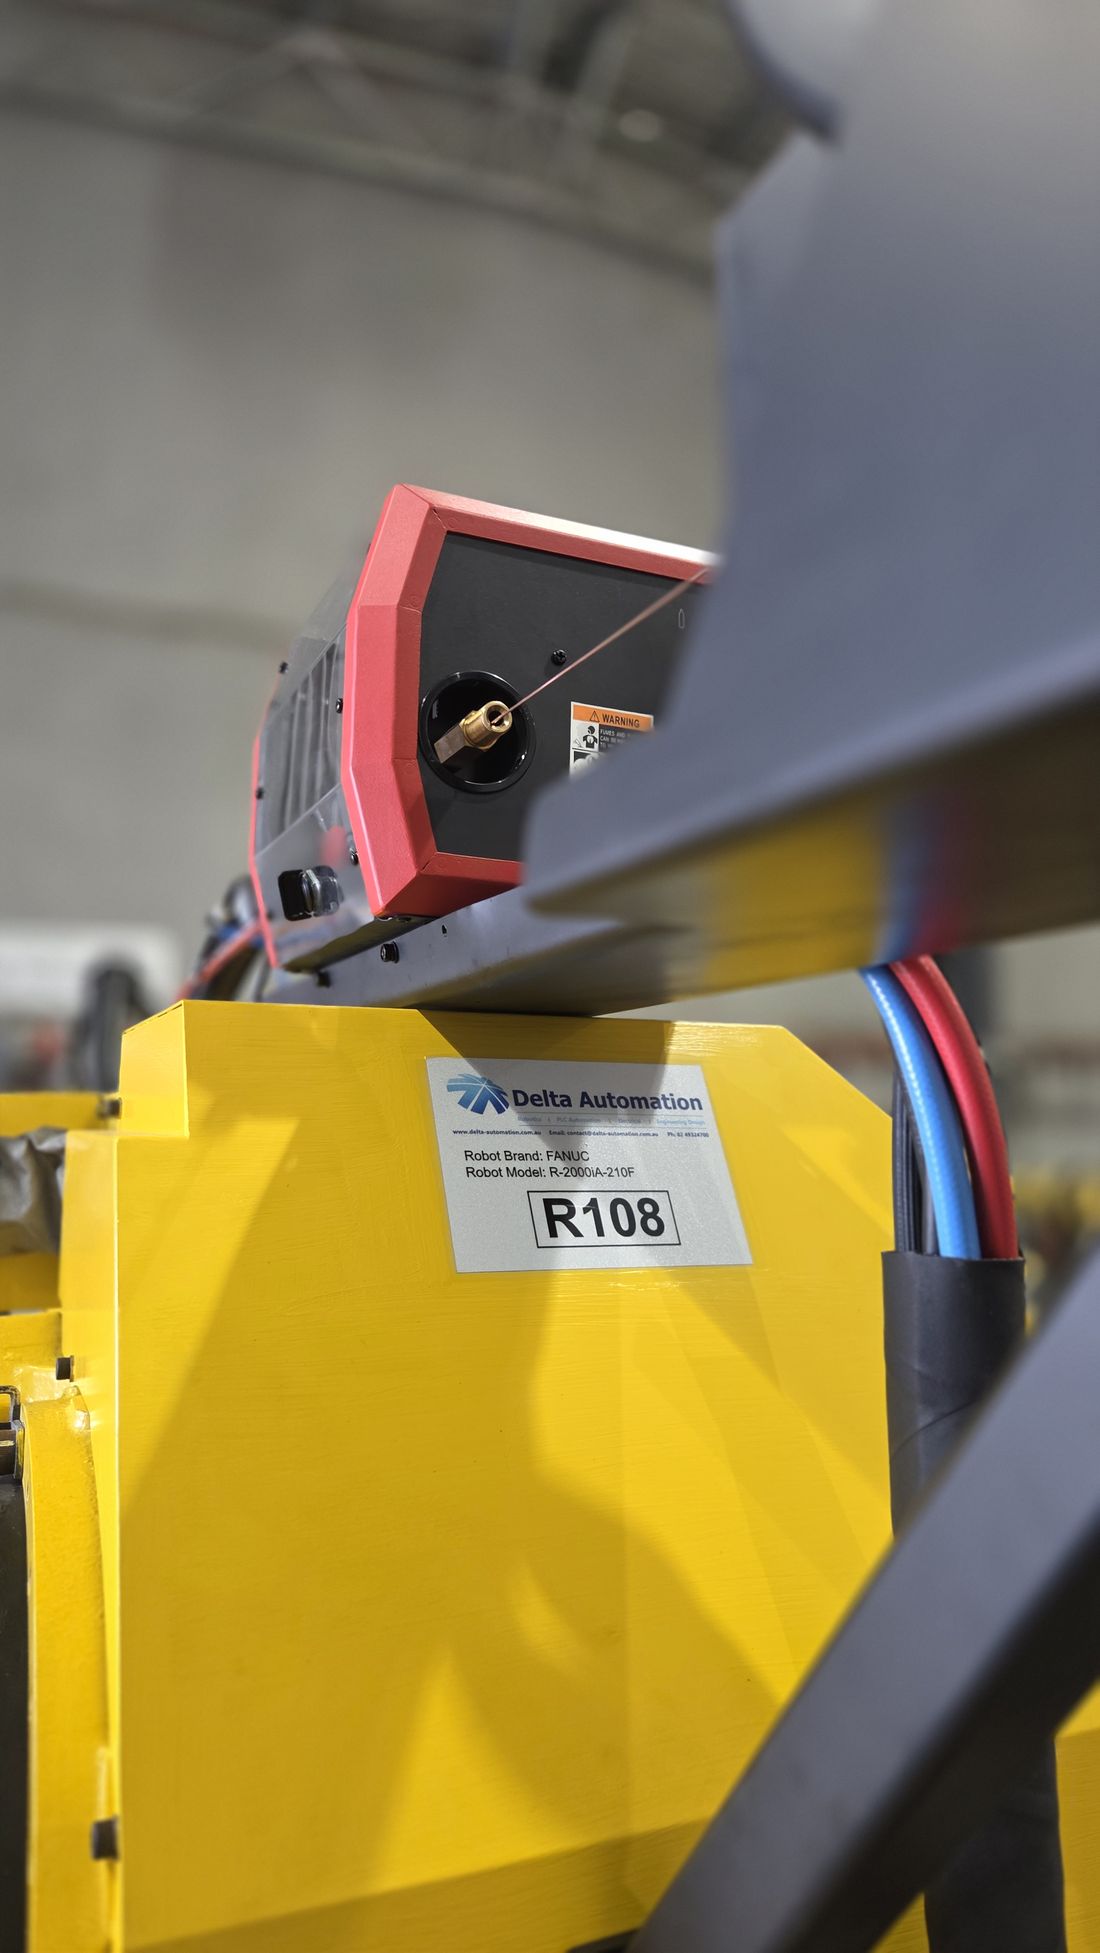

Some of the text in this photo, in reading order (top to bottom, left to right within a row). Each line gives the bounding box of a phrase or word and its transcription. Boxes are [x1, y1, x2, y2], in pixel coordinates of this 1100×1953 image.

[602, 713, 640, 728] WARNING
[600, 728, 615, 737] FUMES
[512, 1089, 703, 1111] Delta Automation
[453, 1128, 542, 1136] www.delta-automation.com.au
[566, 1129, 658, 1138] contact@delta-automation.com.au
[464, 1150, 590, 1162] Robot Brand: FANUC
[466, 1166, 635, 1178] Robot Model: R-2000iA-210F
[542, 1197, 665, 1238] R108
